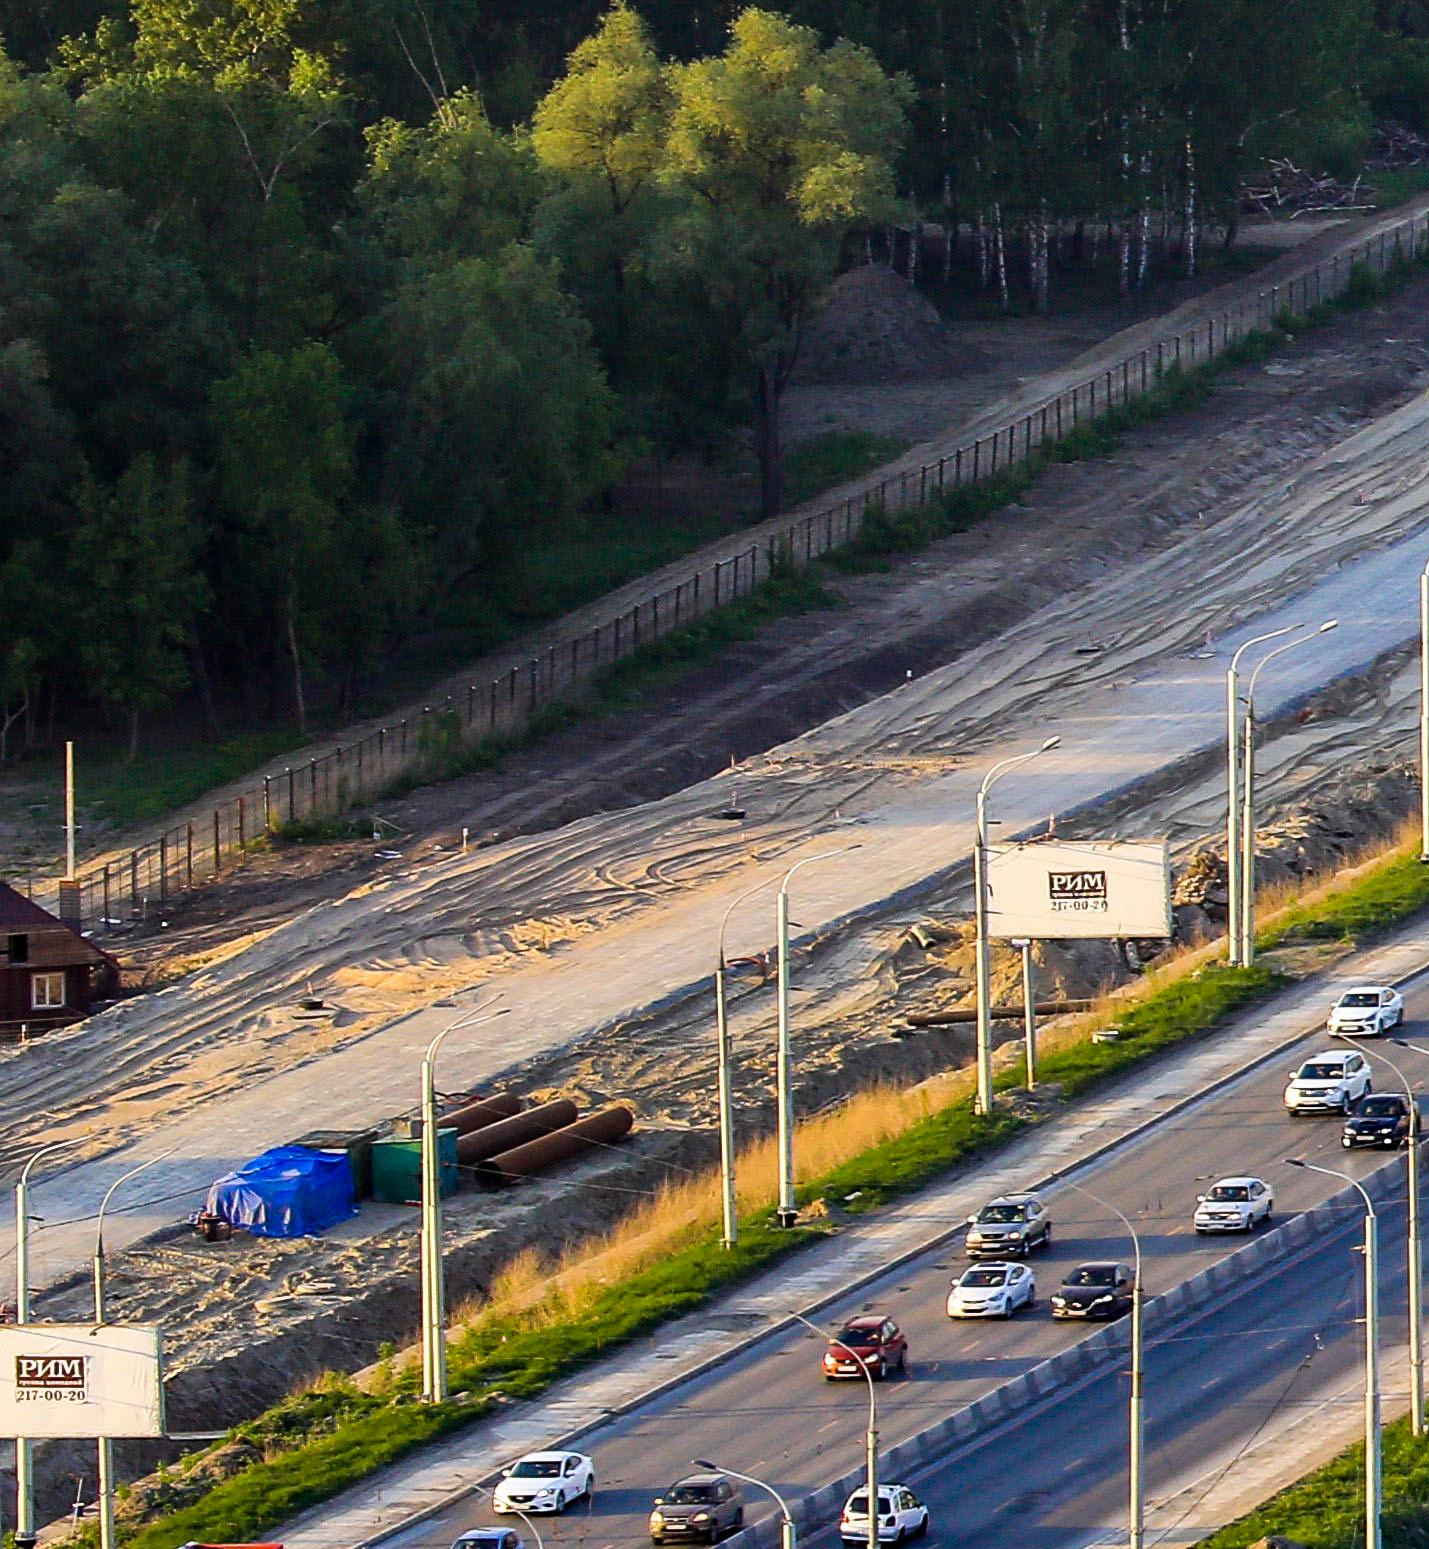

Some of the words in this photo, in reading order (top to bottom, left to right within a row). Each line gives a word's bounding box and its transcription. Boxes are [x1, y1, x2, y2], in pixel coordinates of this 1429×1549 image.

[1051, 873, 1104, 891] РИМ
[18, 1359, 82, 1378] РИМ
[17, 1390, 85, 1401] 217-00-20
